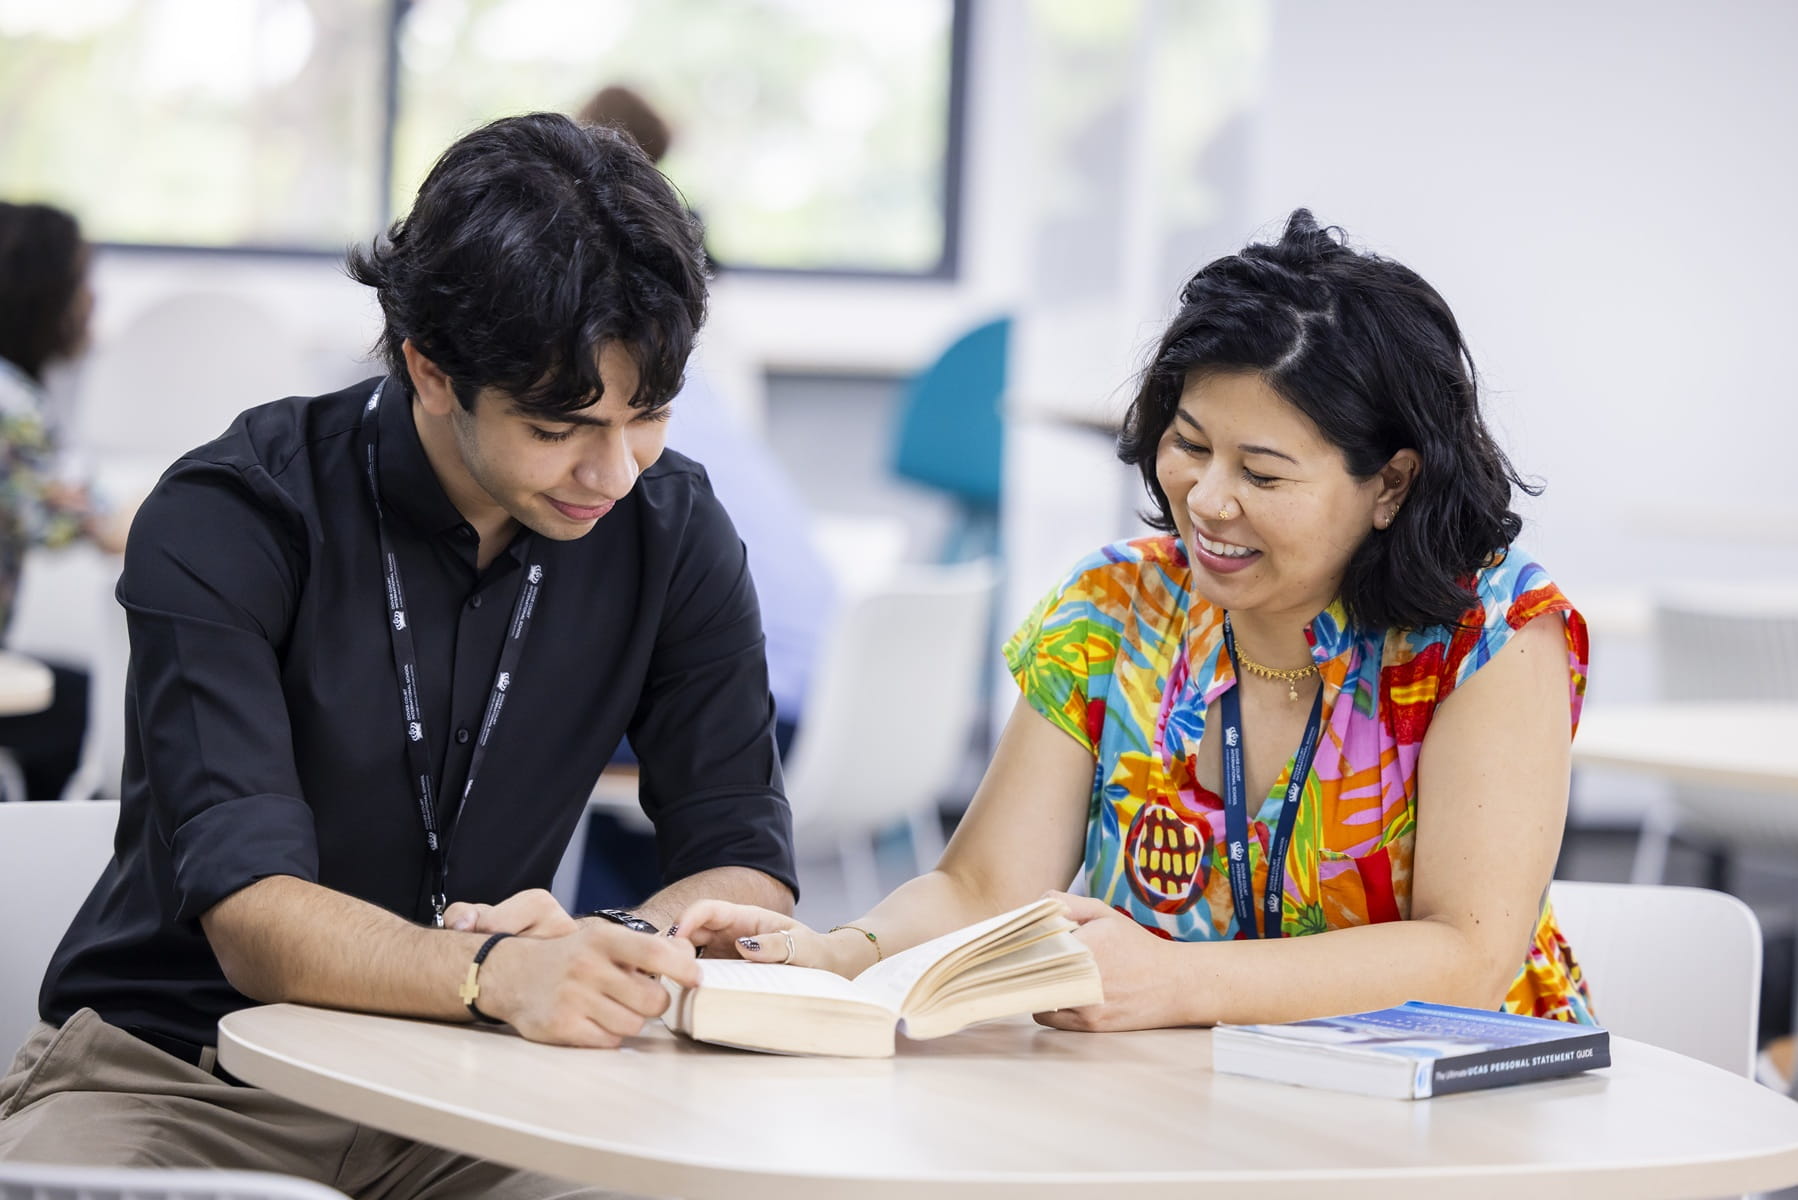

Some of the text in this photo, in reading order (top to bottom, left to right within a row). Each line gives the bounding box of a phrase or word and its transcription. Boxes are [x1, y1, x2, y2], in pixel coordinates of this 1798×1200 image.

[1468, 1064, 1489, 1077] UCAS
[1490, 1058, 1530, 1073] PERSONAL
[1532, 1051, 1575, 1066] STATEMENT
[1576, 1048, 1594, 1059] GUIDE
